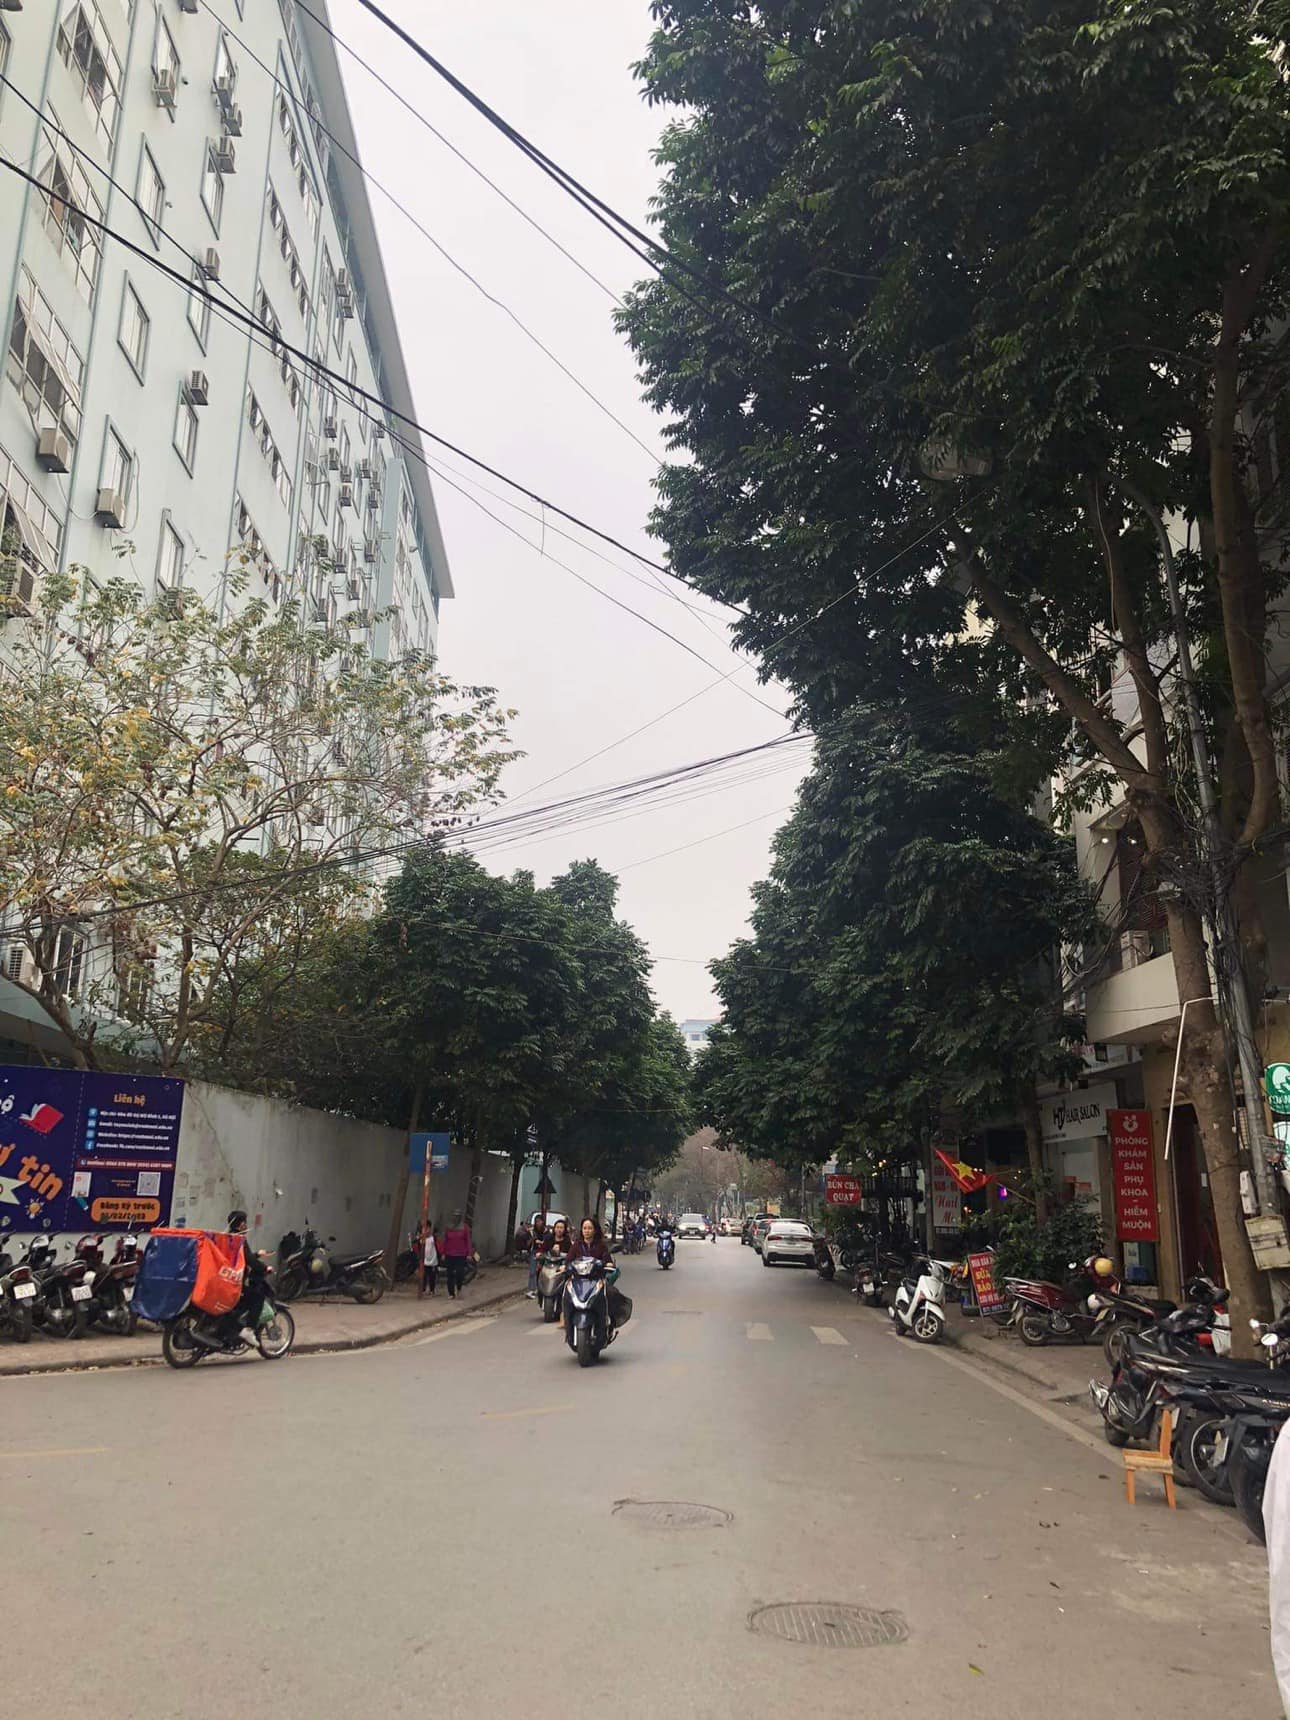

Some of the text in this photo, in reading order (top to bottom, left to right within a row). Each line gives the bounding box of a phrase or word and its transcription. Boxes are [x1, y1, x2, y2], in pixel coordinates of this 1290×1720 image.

[113, 1093, 146, 1107] Liên hệ
[1080, 1104, 1100, 1121] SALON
[1115, 1136, 1148, 1145] PHÒNG
[1118, 1148, 1147, 1158] KHÁM
[18, 1154, 63, 1201] tin
[1124, 1176, 1144, 1185] PHỤ
[1120, 1188, 1148, 1196] KHOA
[1124, 1205, 1148, 1216] HIẾM
[1122, 1220, 1151, 1231] MUỘN
